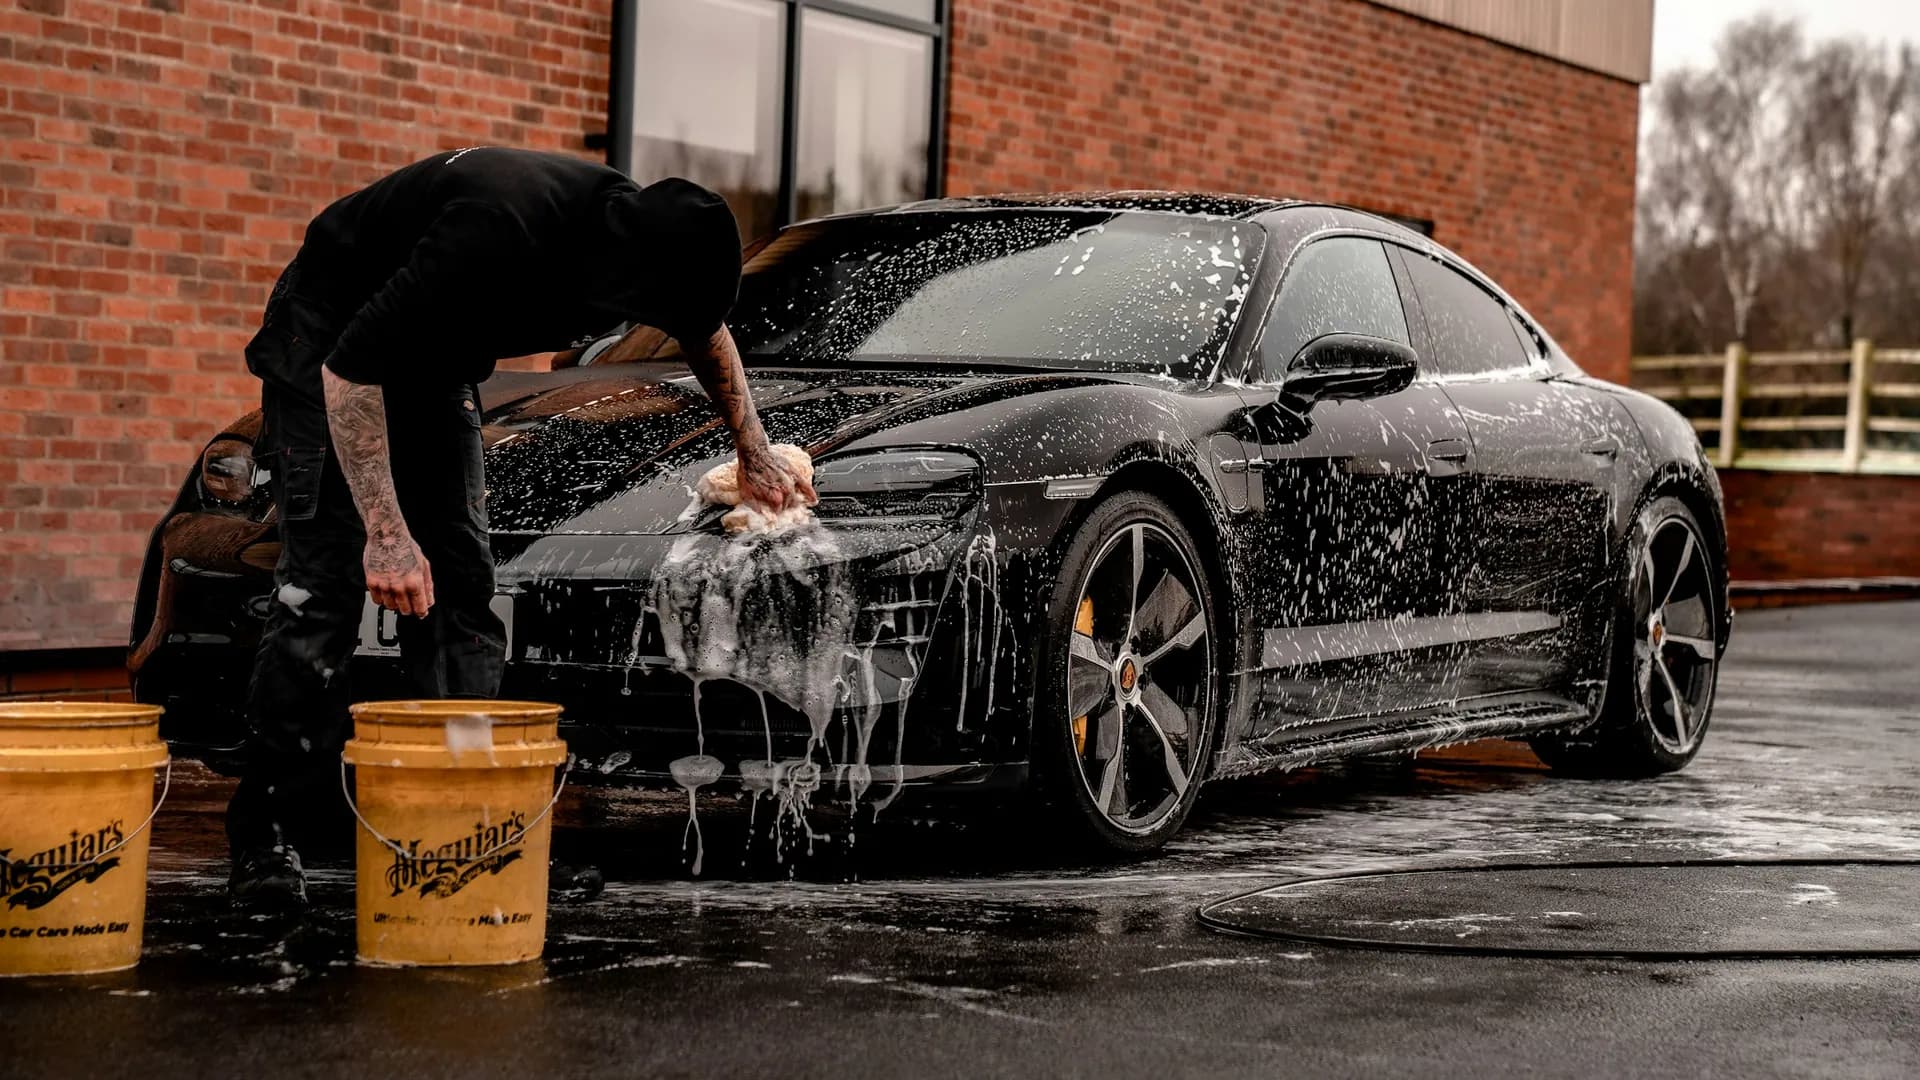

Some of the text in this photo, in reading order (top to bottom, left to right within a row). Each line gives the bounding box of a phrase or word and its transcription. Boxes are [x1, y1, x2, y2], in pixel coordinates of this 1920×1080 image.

[386, 810, 526, 897] Meguiar's
[478, 914, 509, 926] Mae
[511, 912, 532, 924] Easy
[9, 927, 33, 938] Car
[37, 926, 68, 937] Care
[72, 923, 105, 936] Made
[108, 922, 129, 933] Easy
